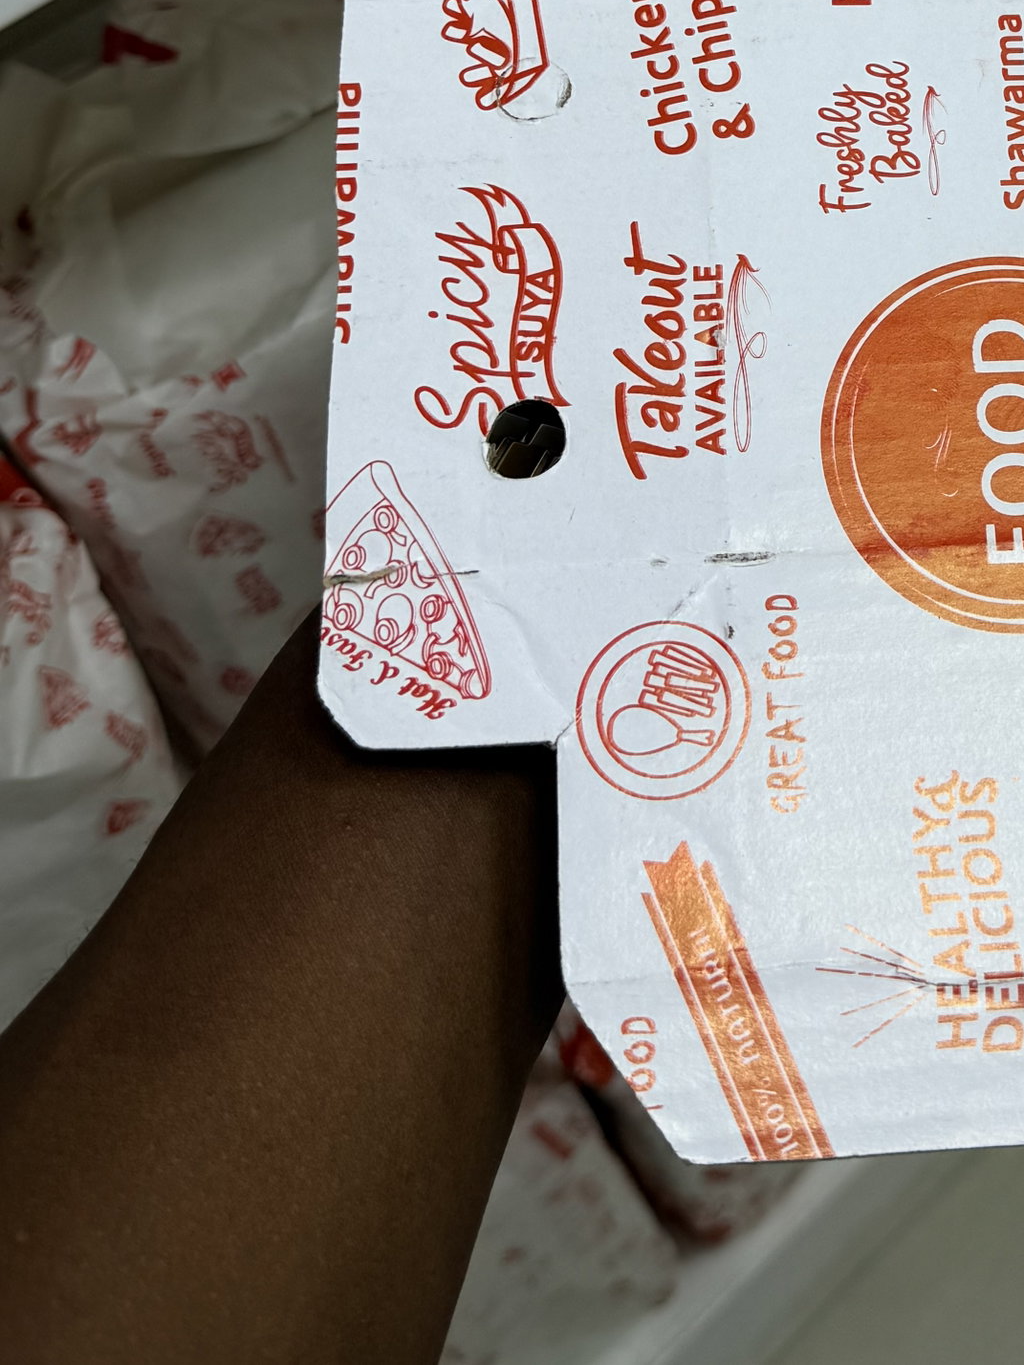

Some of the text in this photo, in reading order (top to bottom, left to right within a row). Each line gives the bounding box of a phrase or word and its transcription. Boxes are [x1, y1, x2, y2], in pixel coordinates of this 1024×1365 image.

[712, 101, 757, 140] &
[816, 82, 871, 215] Freshly
[865, 60, 921, 185] Baked
[413, 219, 503, 437] Spicy
[514, 268, 556, 365] SUYA
[692, 263, 728, 456] AVAILABLE
[761, 593, 807, 815] GREAT FOOD
[753, 1074, 800, 1159] 100%
